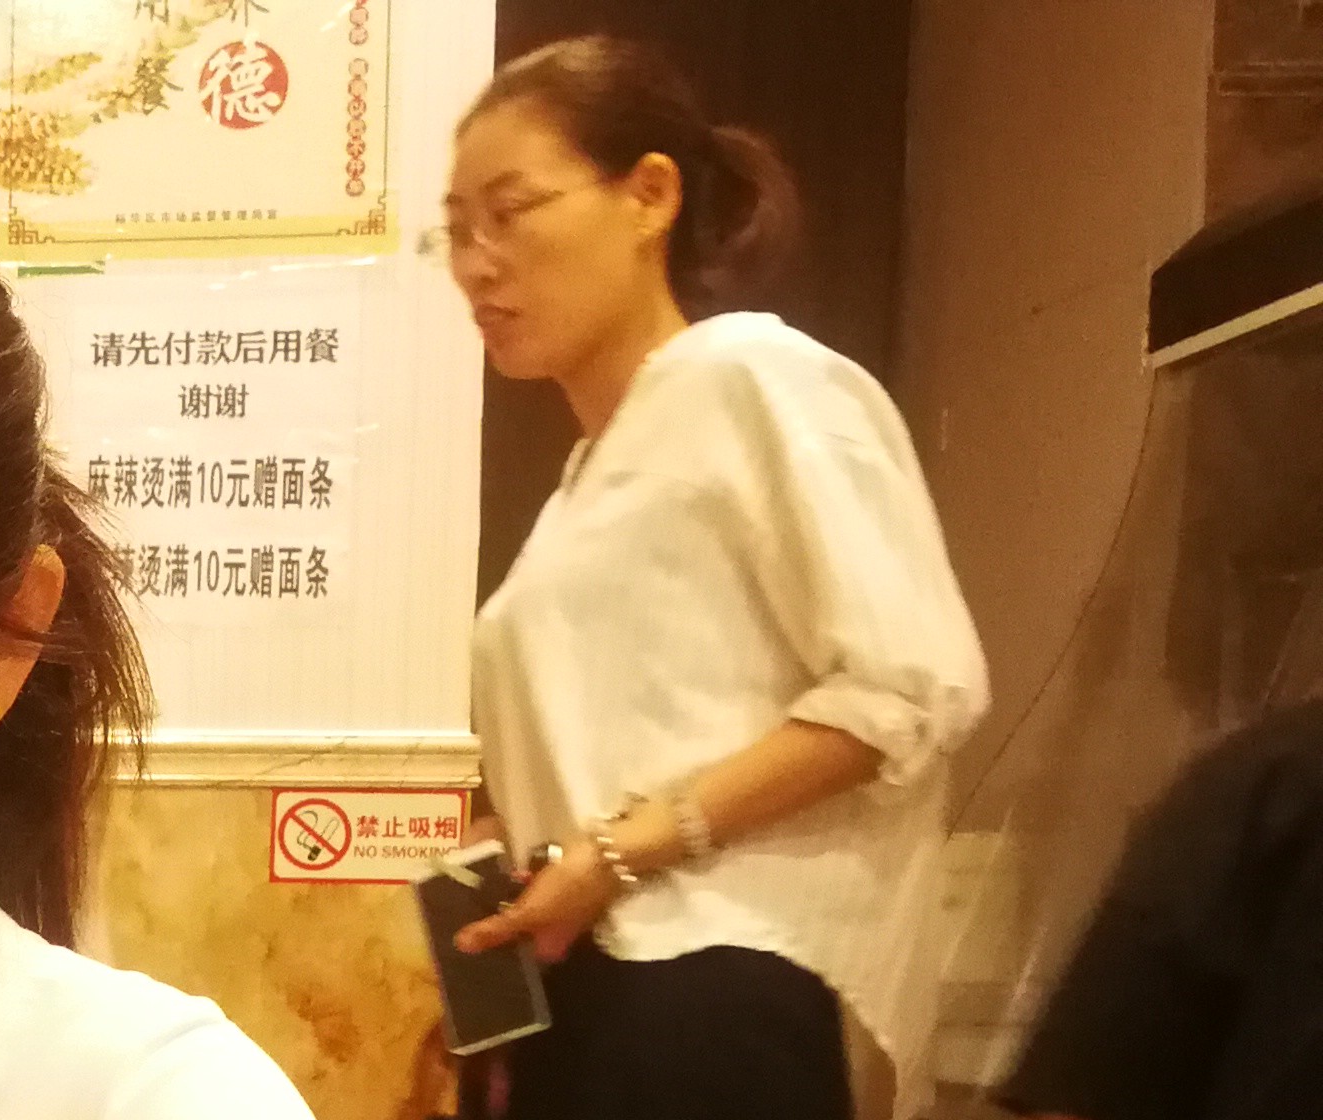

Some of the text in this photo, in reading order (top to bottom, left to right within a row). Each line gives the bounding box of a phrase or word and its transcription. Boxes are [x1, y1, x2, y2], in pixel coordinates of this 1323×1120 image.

[200, 31, 283, 124] 德
[90, 328, 339, 367] 请先付款后用餐
[178, 384, 249, 418] 谢谢
[88, 455, 334, 509] 麻辣烫满10元赠面条
[112, 544, 329, 598] 辣烫满10元赠面条
[357, 815, 457, 839] 禁止吸烟
[354, 845, 377, 858] NO
